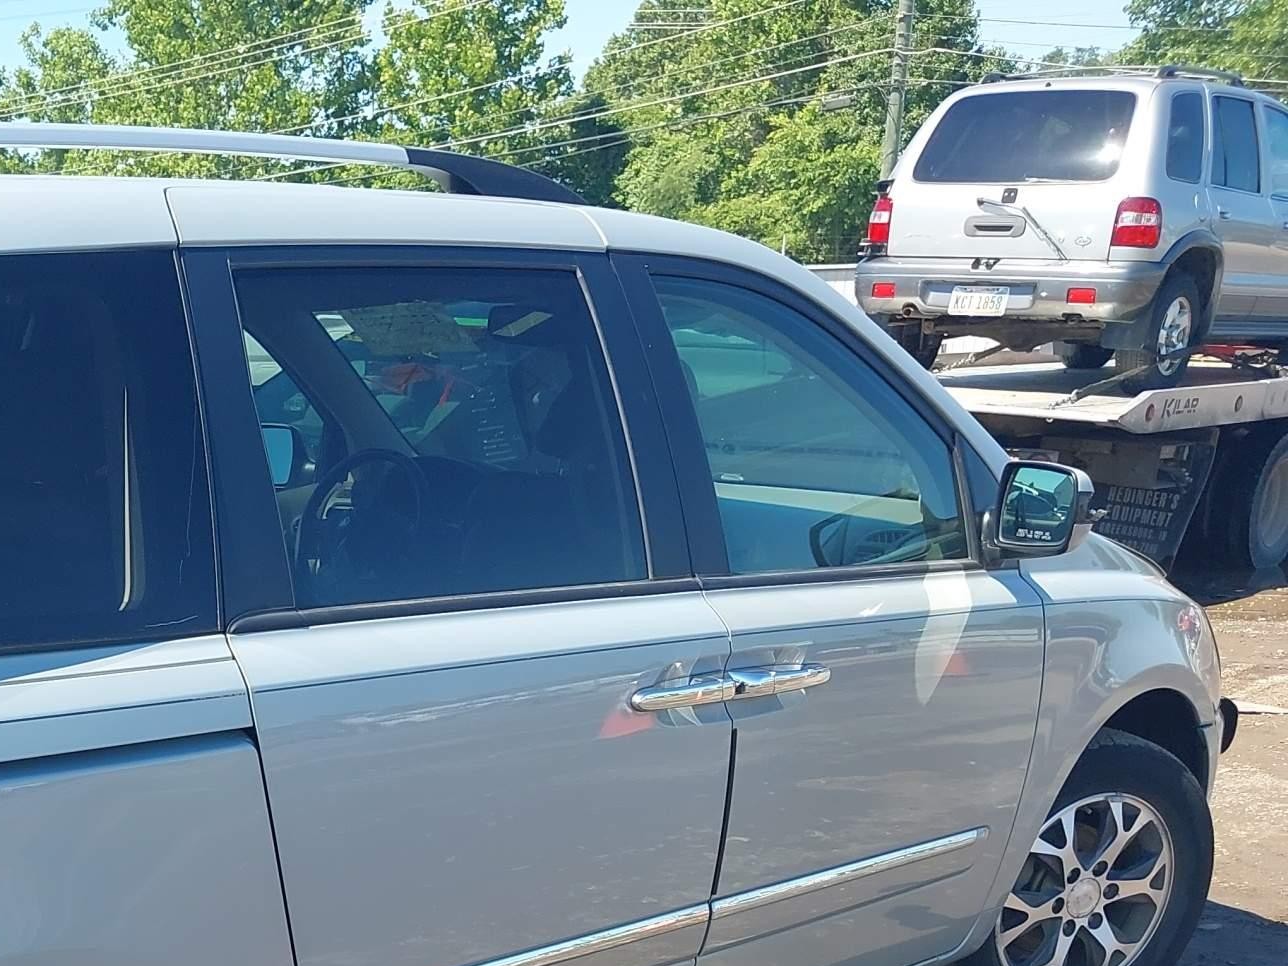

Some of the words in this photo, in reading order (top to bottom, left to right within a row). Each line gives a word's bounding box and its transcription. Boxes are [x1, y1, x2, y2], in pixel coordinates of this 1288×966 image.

[975, 295, 1003, 311] 1858
[1161, 397, 1200, 418] KILAR
[1103, 504, 1174, 528] EQUIPMENT
